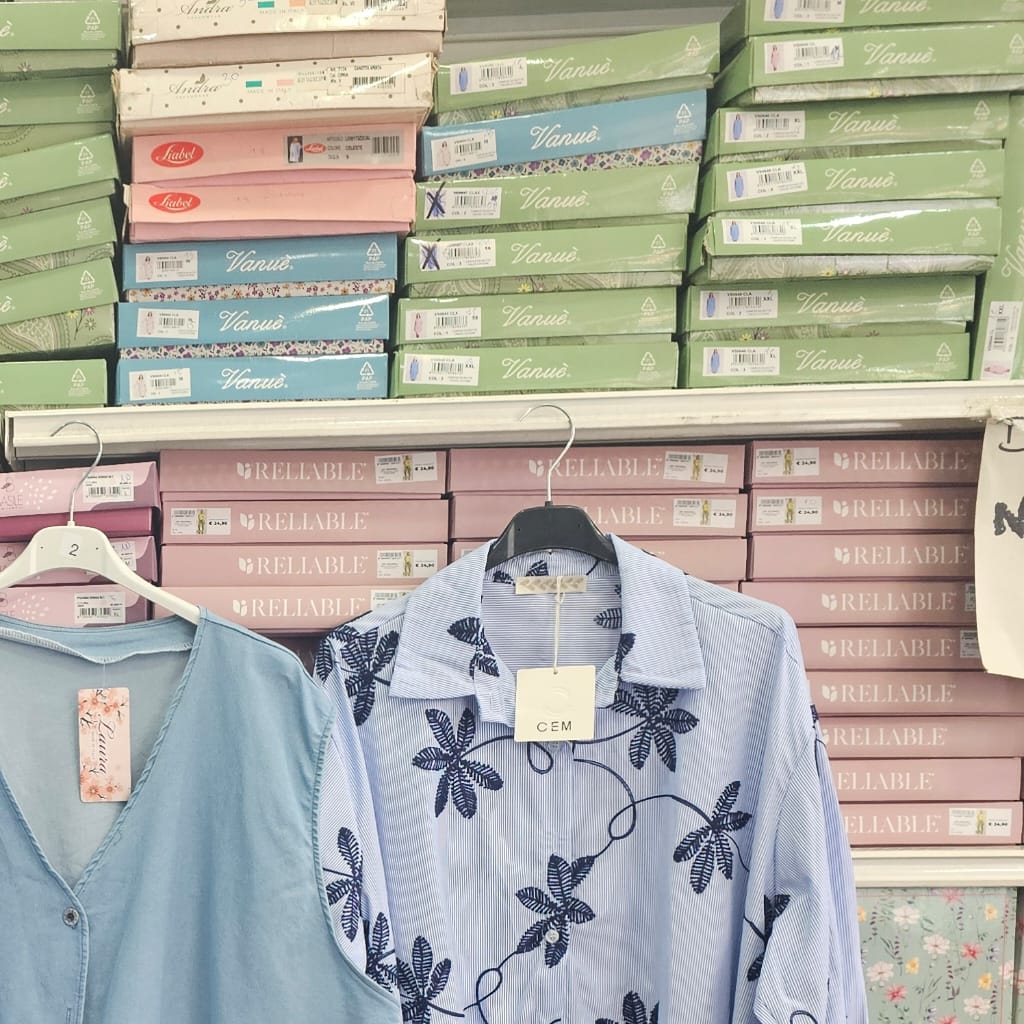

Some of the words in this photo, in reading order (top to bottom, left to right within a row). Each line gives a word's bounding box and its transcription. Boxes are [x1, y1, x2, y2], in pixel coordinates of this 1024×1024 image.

[154, 142, 197, 165] Liabel
[152, 193, 194, 211] Liabel
[854, 452, 968, 471] RELIABLE
[255, 462, 365, 481] RELIABLE
[853, 499, 967, 518] RELIABLE
[258, 513, 367, 531] RELIABLE
[69, 543, 80, 557] 2
[854, 546, 967, 565] RELIABLE
[257, 557, 367, 575] RELIABLE
[252, 598, 363, 617] RELIABLE
[841, 593, 955, 611] RELIABLE
[841, 639, 954, 657] RELIABLE
[841, 684, 953, 703] RELIABLE
[536, 721, 572, 733] CEM
[97, 714, 116, 775] Laura
[834, 728, 946, 746] RELIABLE
[837, 772, 933, 790] ELIABLE
[845, 816, 939, 834] ELIABLE
